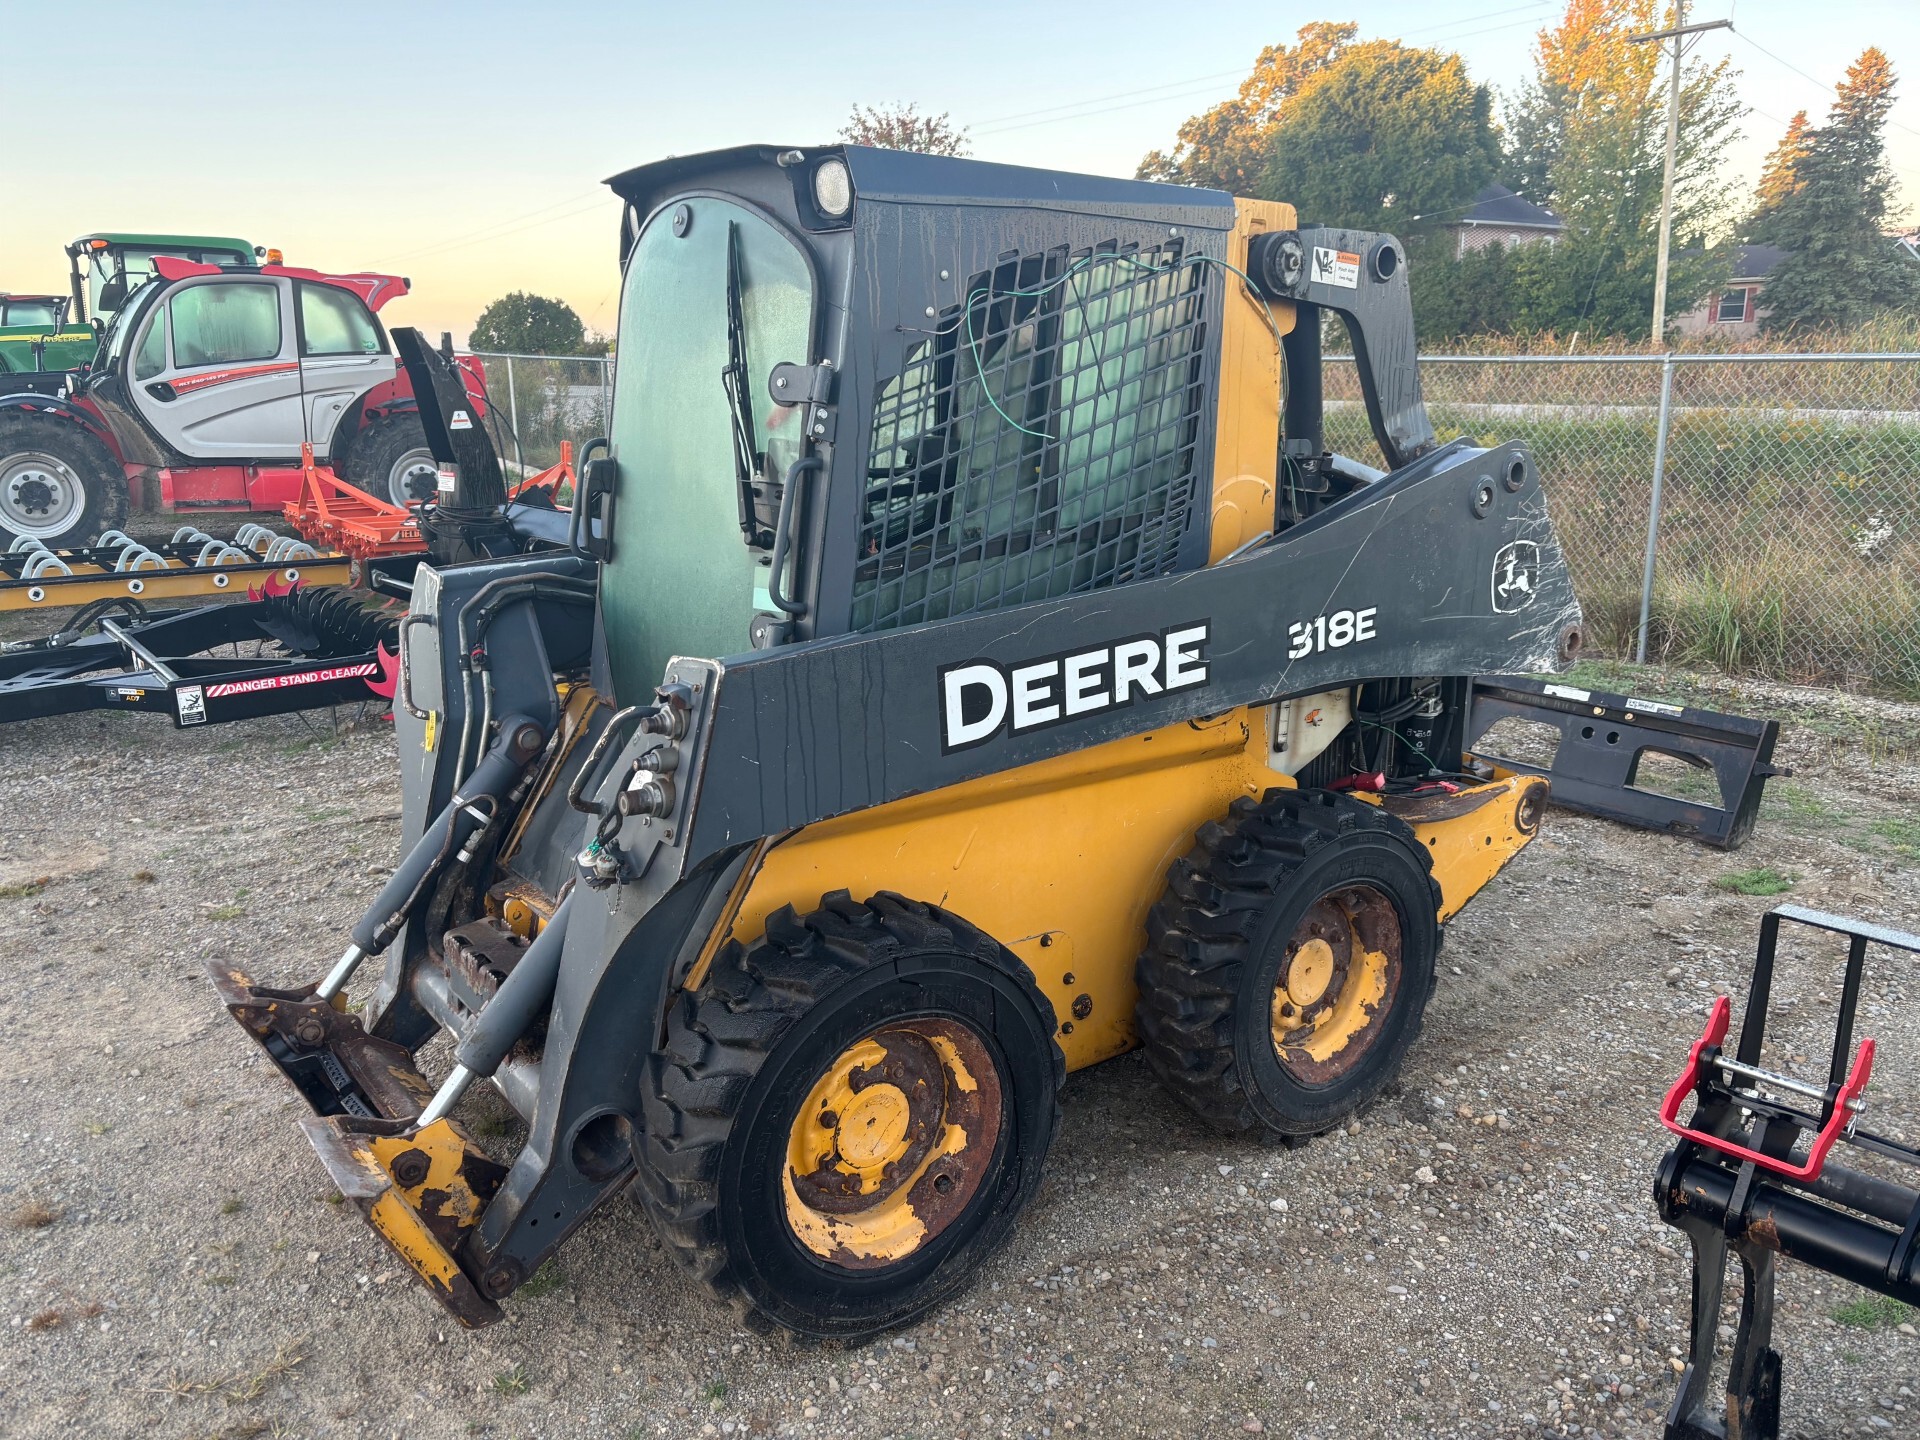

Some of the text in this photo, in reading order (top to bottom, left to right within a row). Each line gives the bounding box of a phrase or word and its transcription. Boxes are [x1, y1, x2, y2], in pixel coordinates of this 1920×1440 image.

[1288, 606, 1377, 660] 318E
[226, 667, 358, 694] DANGER STAND CLEAR
[944, 625, 1207, 747] DEERE
